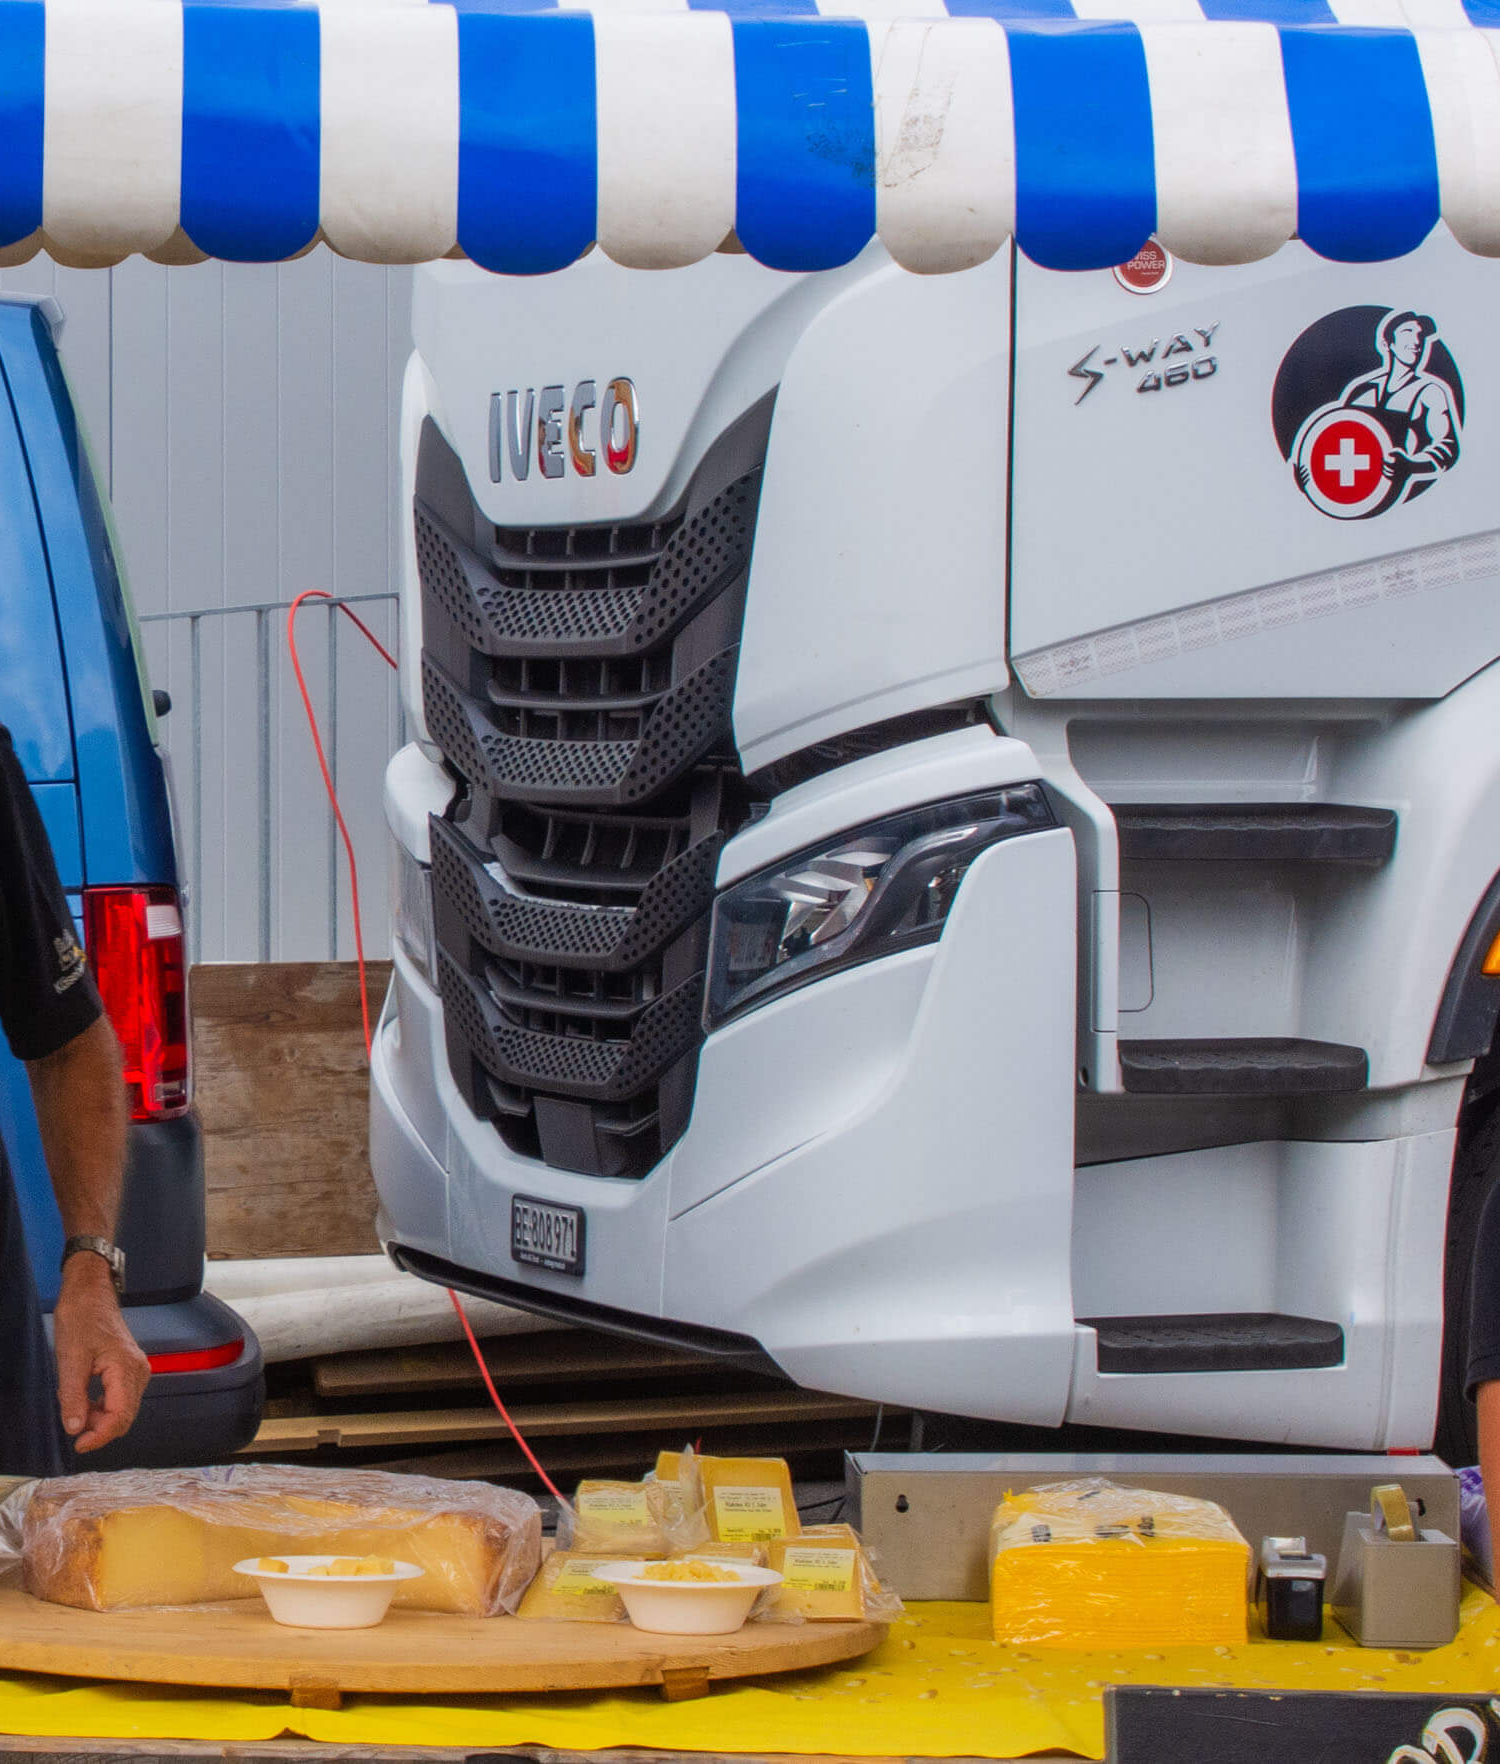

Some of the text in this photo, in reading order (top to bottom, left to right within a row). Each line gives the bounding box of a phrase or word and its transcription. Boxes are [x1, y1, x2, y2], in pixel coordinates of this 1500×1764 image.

[1126, 260, 1165, 271] POWER
[1136, 355, 1217, 393] 460
[488, 376, 640, 484] IVECO
